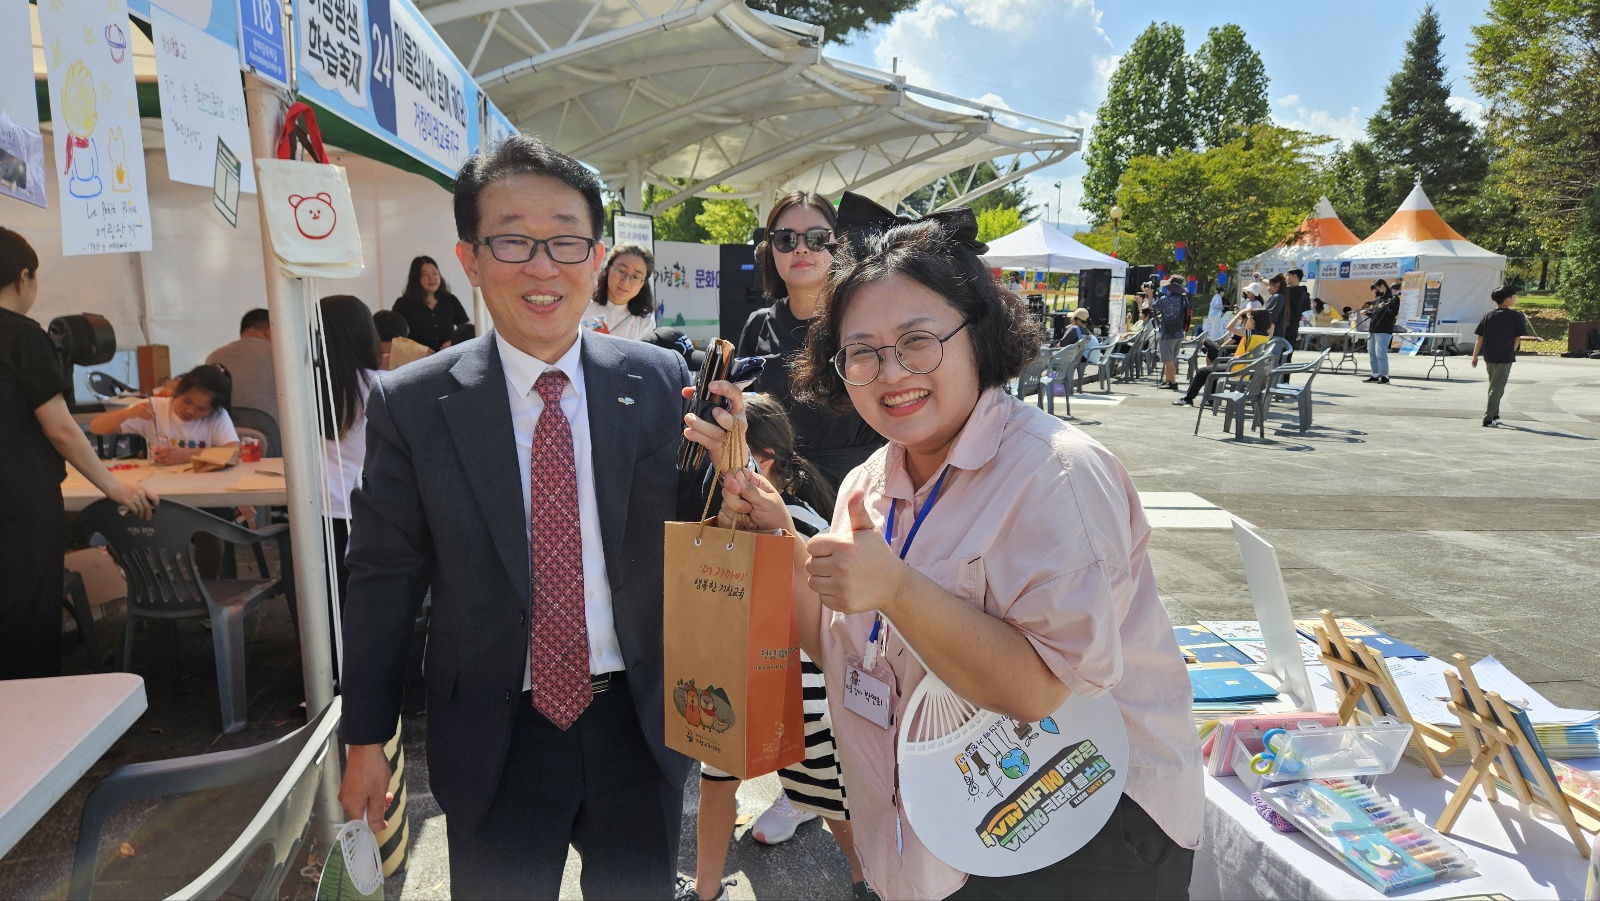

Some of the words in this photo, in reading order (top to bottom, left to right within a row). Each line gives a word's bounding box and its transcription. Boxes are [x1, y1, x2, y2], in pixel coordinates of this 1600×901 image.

[252, 0, 274, 35] 118
[308, 16, 362, 95] 학습축제
[372, 23, 392, 89] 24
[394, 21, 436, 104] 마을강사와
[413, 101, 460, 161] 거창미래교육지구
[1341, 266, 1350, 274] 23
[694, 577, 717, 593] 행복한
[719, 584, 745, 600] 거창교육
[1055, 739, 1098, 777] 당신의
[1072, 755, 1111, 790] 지구를
[1040, 781, 1077, 814] 살리는
[1086, 779, 1103, 794] 1kWh
[1000, 808, 1050, 852] 에센스
